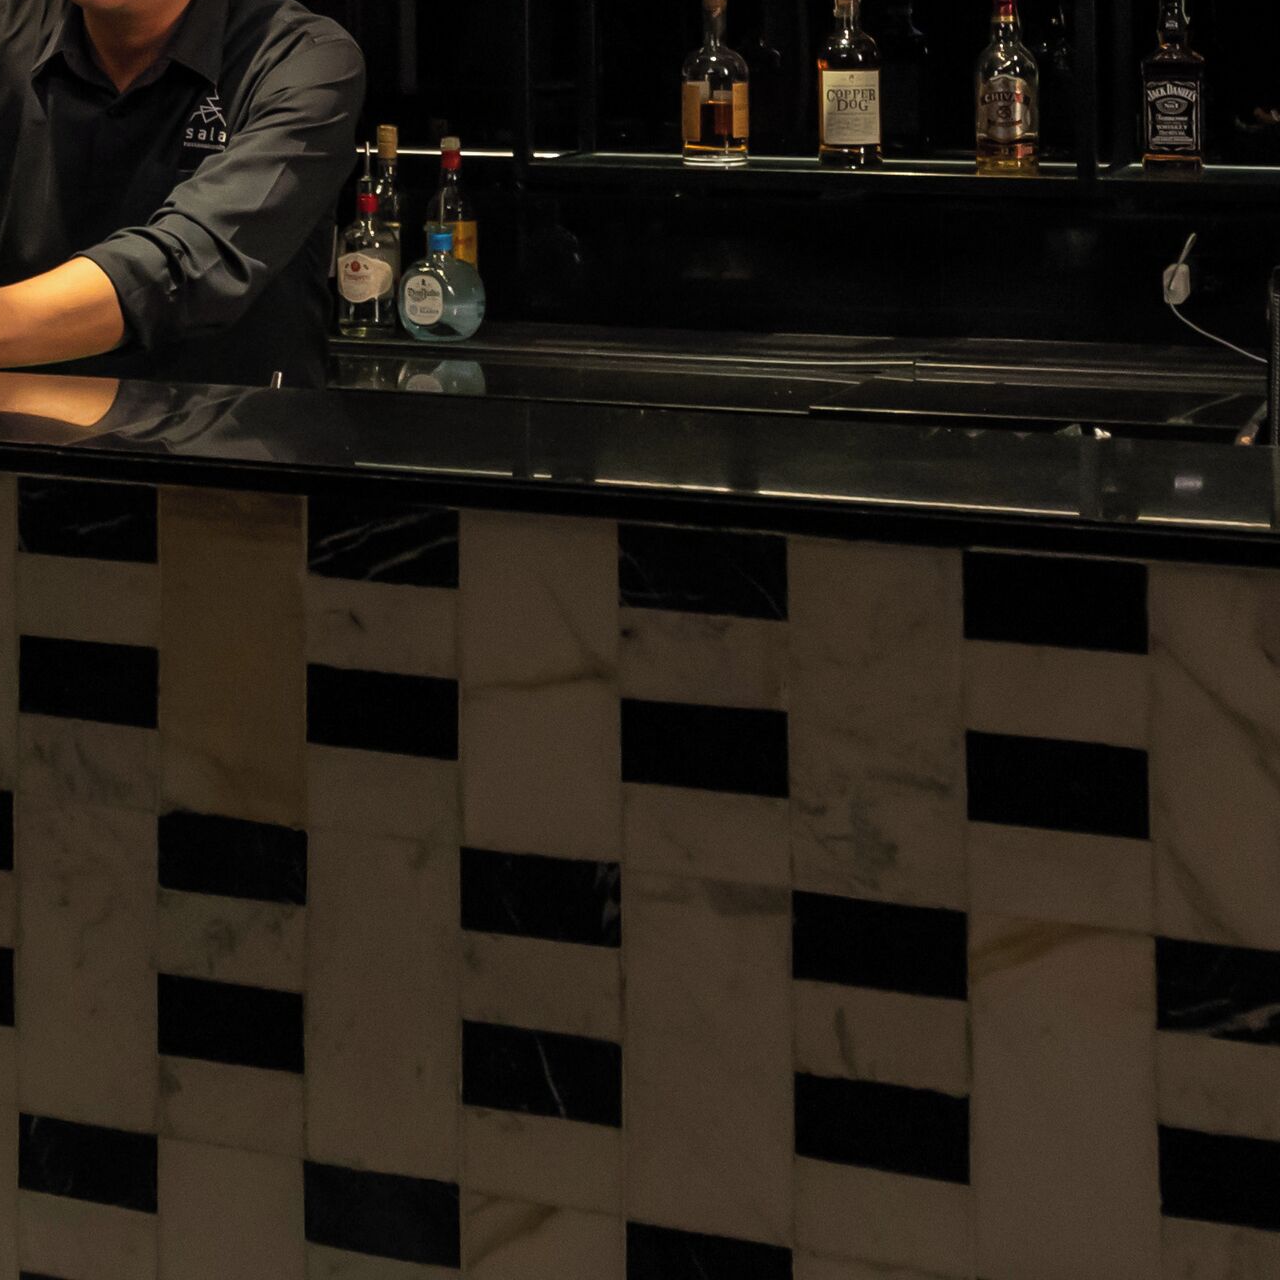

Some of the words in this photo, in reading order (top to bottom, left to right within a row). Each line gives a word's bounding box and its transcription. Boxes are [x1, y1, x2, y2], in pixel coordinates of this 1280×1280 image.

[826, 89, 876, 102] COPPER
[1147, 86, 1167, 101] JACK
[837, 99, 868, 111] DOG
[185, 127, 227, 143] sala
